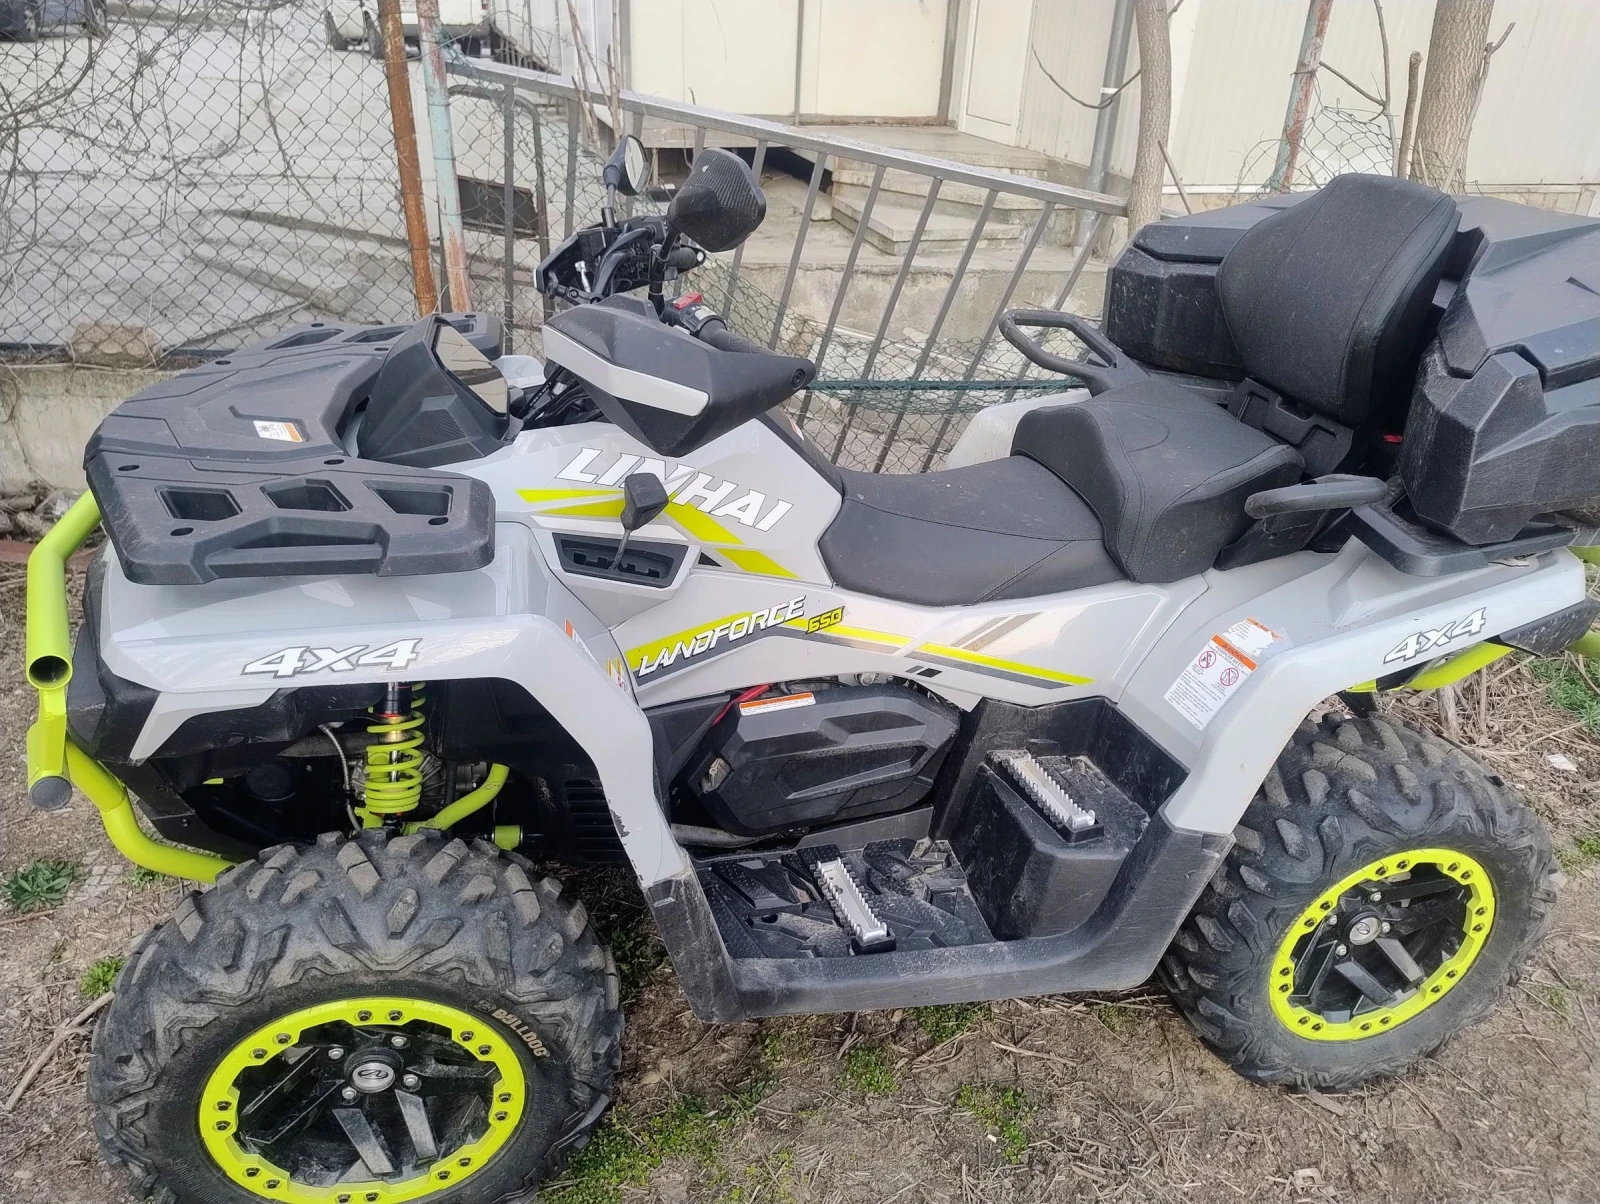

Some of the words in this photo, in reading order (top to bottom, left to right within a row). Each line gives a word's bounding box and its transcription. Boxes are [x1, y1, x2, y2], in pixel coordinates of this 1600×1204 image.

[555, 447, 794, 532] LINHAI
[637, 595, 807, 677] LANDFORCE
[806, 606, 845, 635] 650
[492, 1008, 548, 1057] BULLDOG
